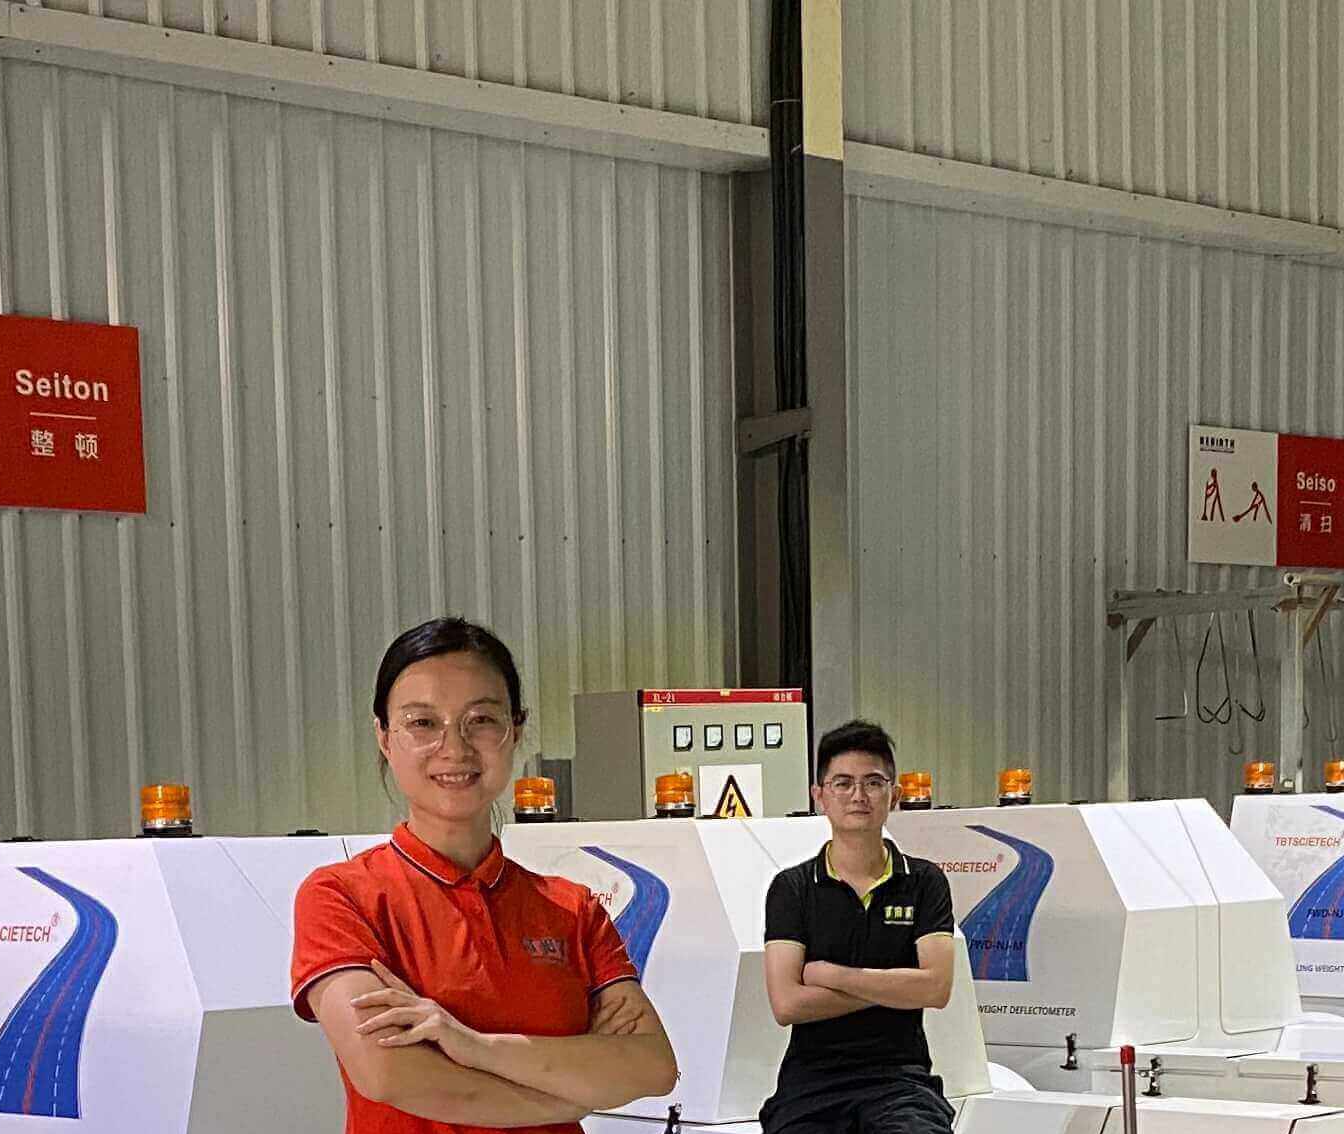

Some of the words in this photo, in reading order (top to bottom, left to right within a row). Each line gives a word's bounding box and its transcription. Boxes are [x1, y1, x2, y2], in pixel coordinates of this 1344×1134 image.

[16, 369, 109, 401] Seiton
[31, 430, 98, 459] 整顿
[1296, 471, 1336, 492] Seiso
[937, 862, 997, 873] TSCIETECH
[1009, 1006, 1076, 1017] DEFLECTOMETER
